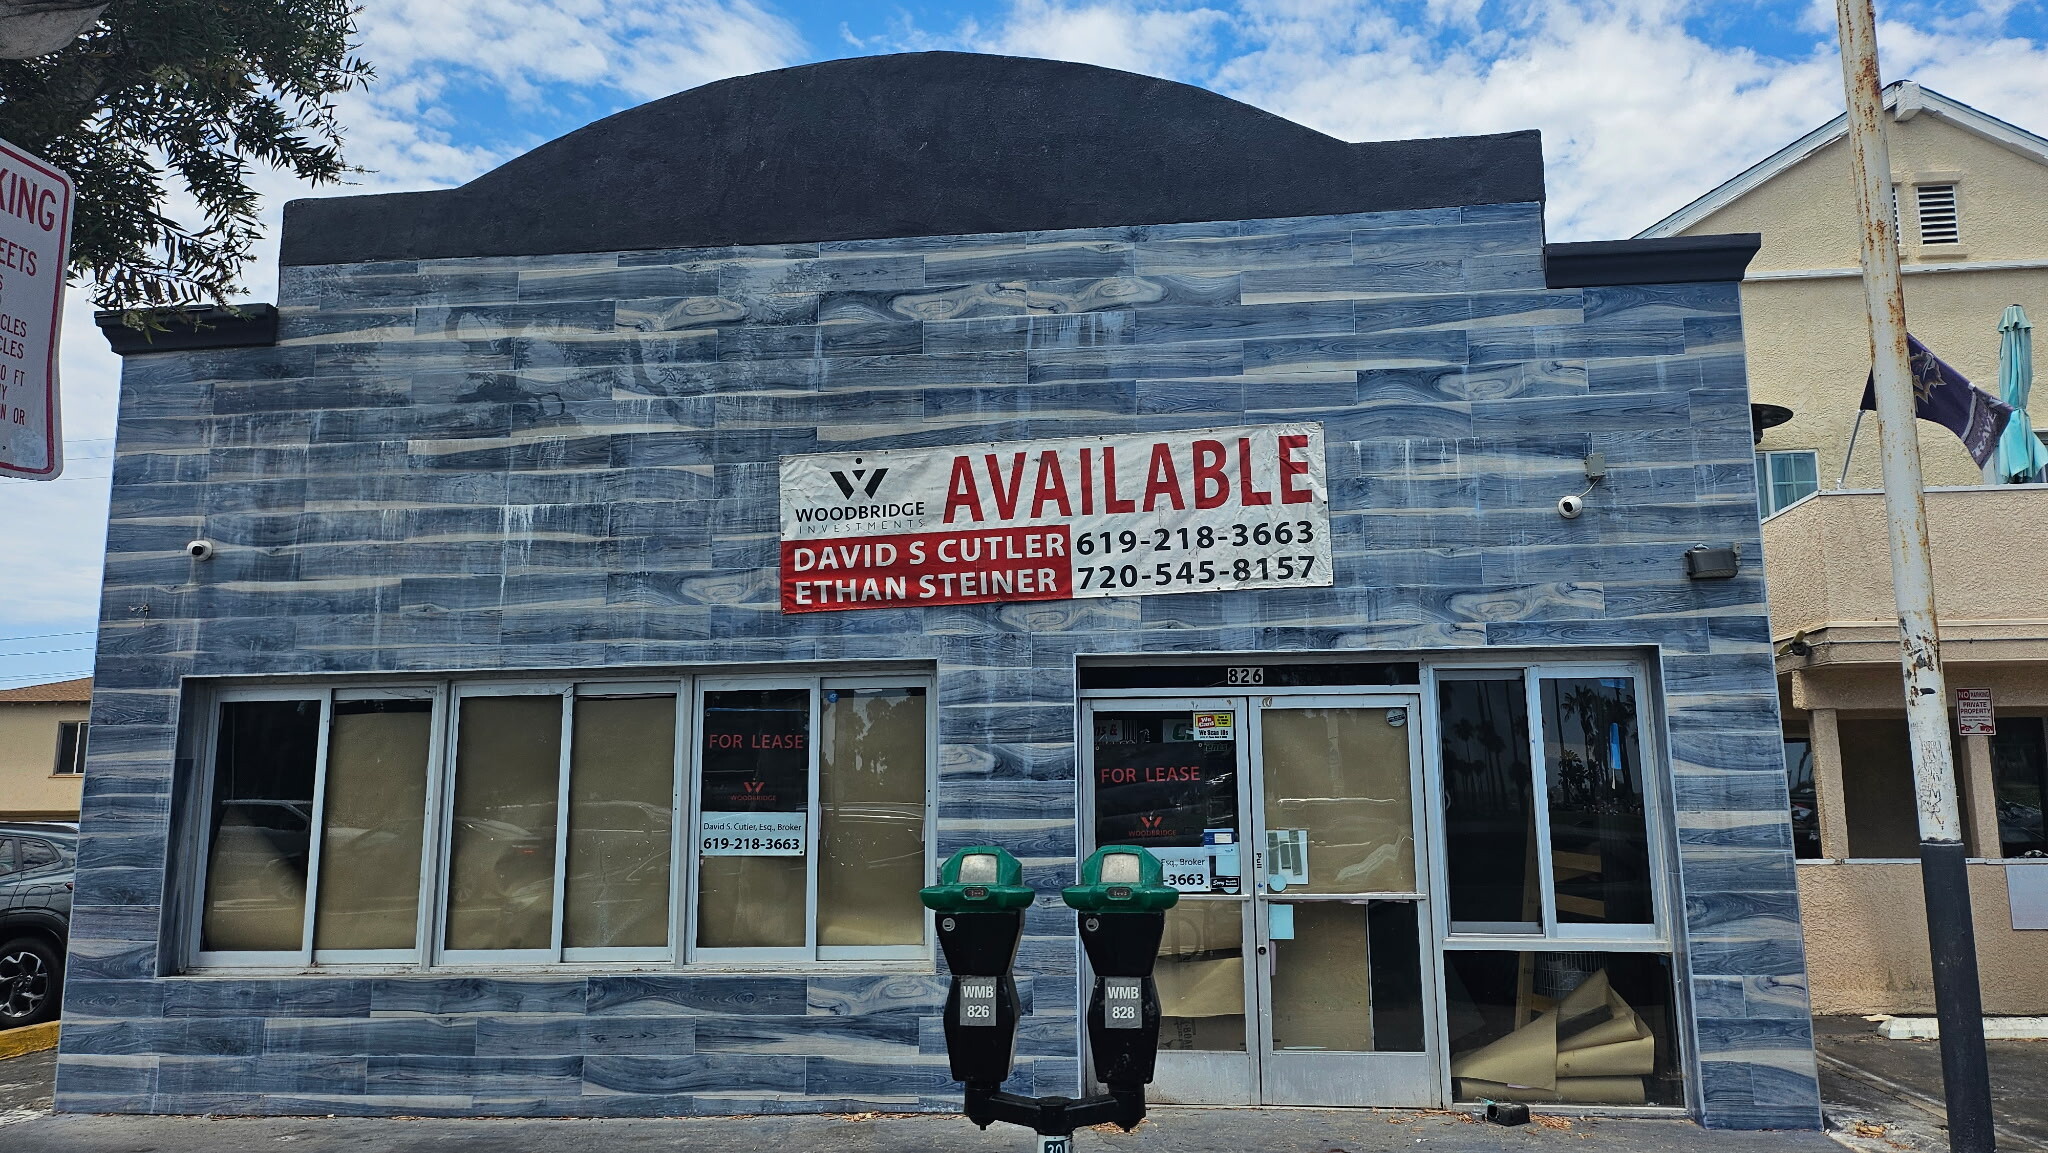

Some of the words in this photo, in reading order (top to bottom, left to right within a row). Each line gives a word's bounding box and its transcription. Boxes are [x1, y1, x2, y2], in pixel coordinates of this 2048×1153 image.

[13, 369, 25, 387] FT
[13, 407, 25, 426] OR
[942, 434, 1314, 524] AVAILABLE
[795, 501, 925, 523] WOODBRIDGE
[798, 518, 926, 535] INVESTMENTS
[1076, 520, 1314, 556] 619-218-3663
[793, 543, 898, 573] DAVID
[909, 541, 926, 565] S
[937, 533, 1066, 563] CUTLER
[1077, 555, 1316, 591] 720-545-8157
[795, 576, 907, 605] ETHAN
[918, 567, 1059, 599] STEINER
[1228, 668, 1263, 684] 826
[709, 734, 743, 749] FOR
[751, 734, 804, 749] LEASE
[1101, 768, 1137, 783] FOR
[1145, 766, 1201, 782] LEASE
[703, 822, 725, 831] David
[777, 823, 802, 831] Broker
[1128, 829, 1177, 837] WOODBRIDGE
[703, 837, 800, 850] 619-218-3663
[1179, 857, 1206, 867] Broker
[1255, 852, 1263, 869] Pull
[963, 985, 994, 999] WMB
[1107, 986, 1139, 1000] WMB
[966, 1005, 990, 1018] 826
[1111, 1006, 1135, 1020] 828
